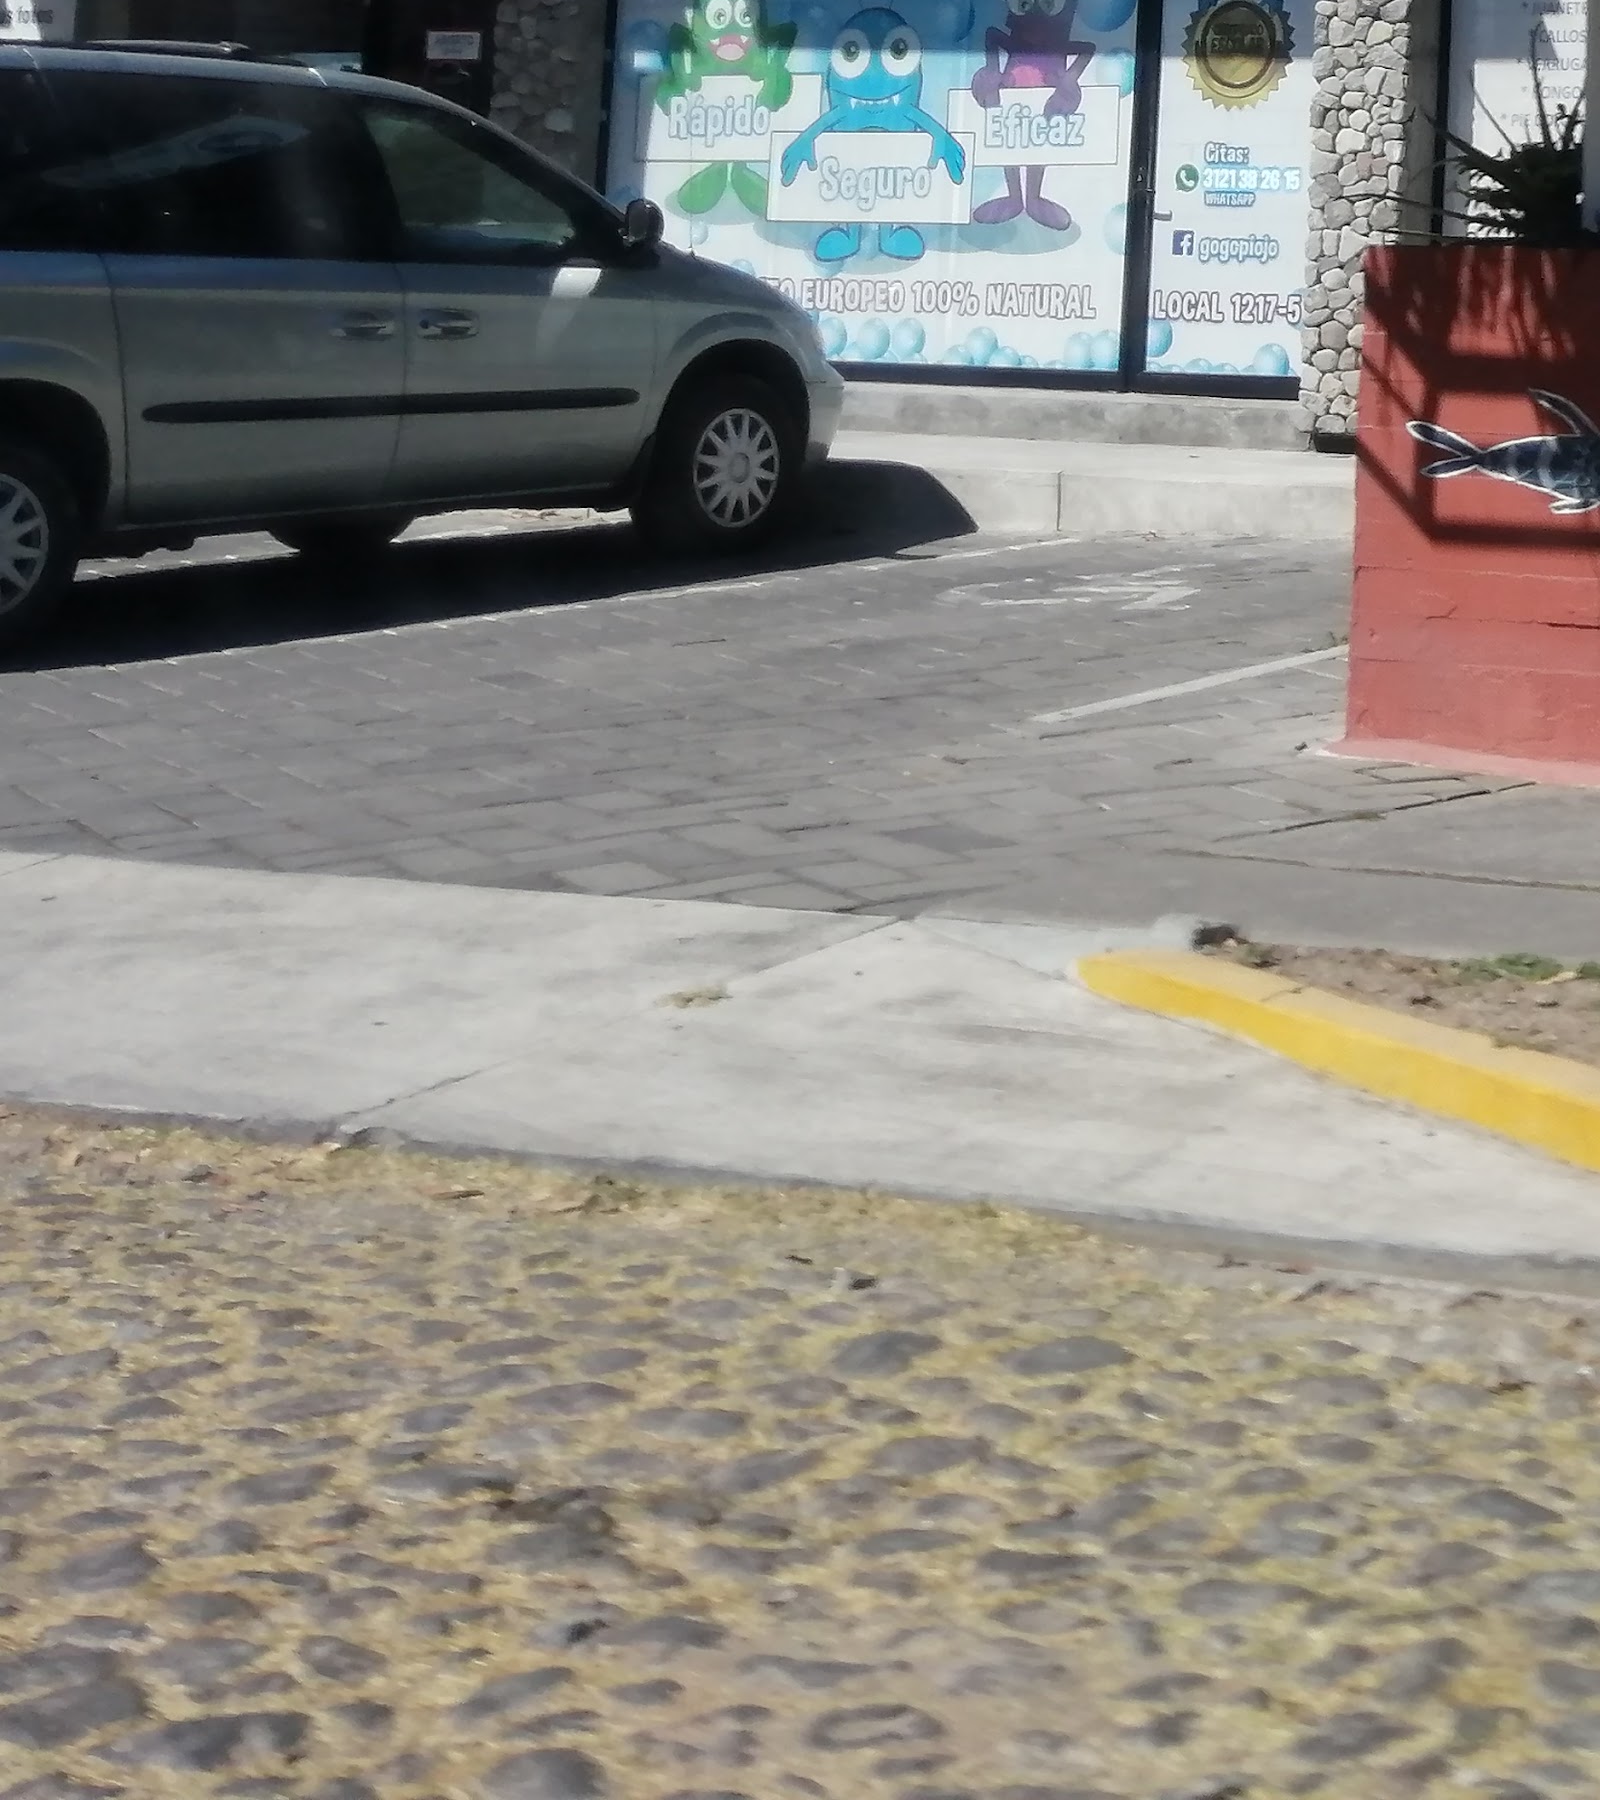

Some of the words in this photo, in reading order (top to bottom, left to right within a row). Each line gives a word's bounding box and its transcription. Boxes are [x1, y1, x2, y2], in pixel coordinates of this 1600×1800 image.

[668, 93, 772, 149] Rápido
[984, 105, 1086, 149] Eficaz
[1202, 141, 1250, 164] Citas:
[818, 156, 934, 211] Seguro
[1201, 167, 1237, 190] 3121
[1282, 167, 1300, 190] 15
[1204, 190, 1256, 207] WHATSAPP
[1198, 233, 1279, 264] gogopiojo
[802, 279, 904, 315] EUROPEO
[911, 281, 982, 316] 100%
[984, 283, 1097, 320] NATURAL
[1153, 290, 1225, 322] LOCAL
[1230, 293, 1303, 324] 1217-5
